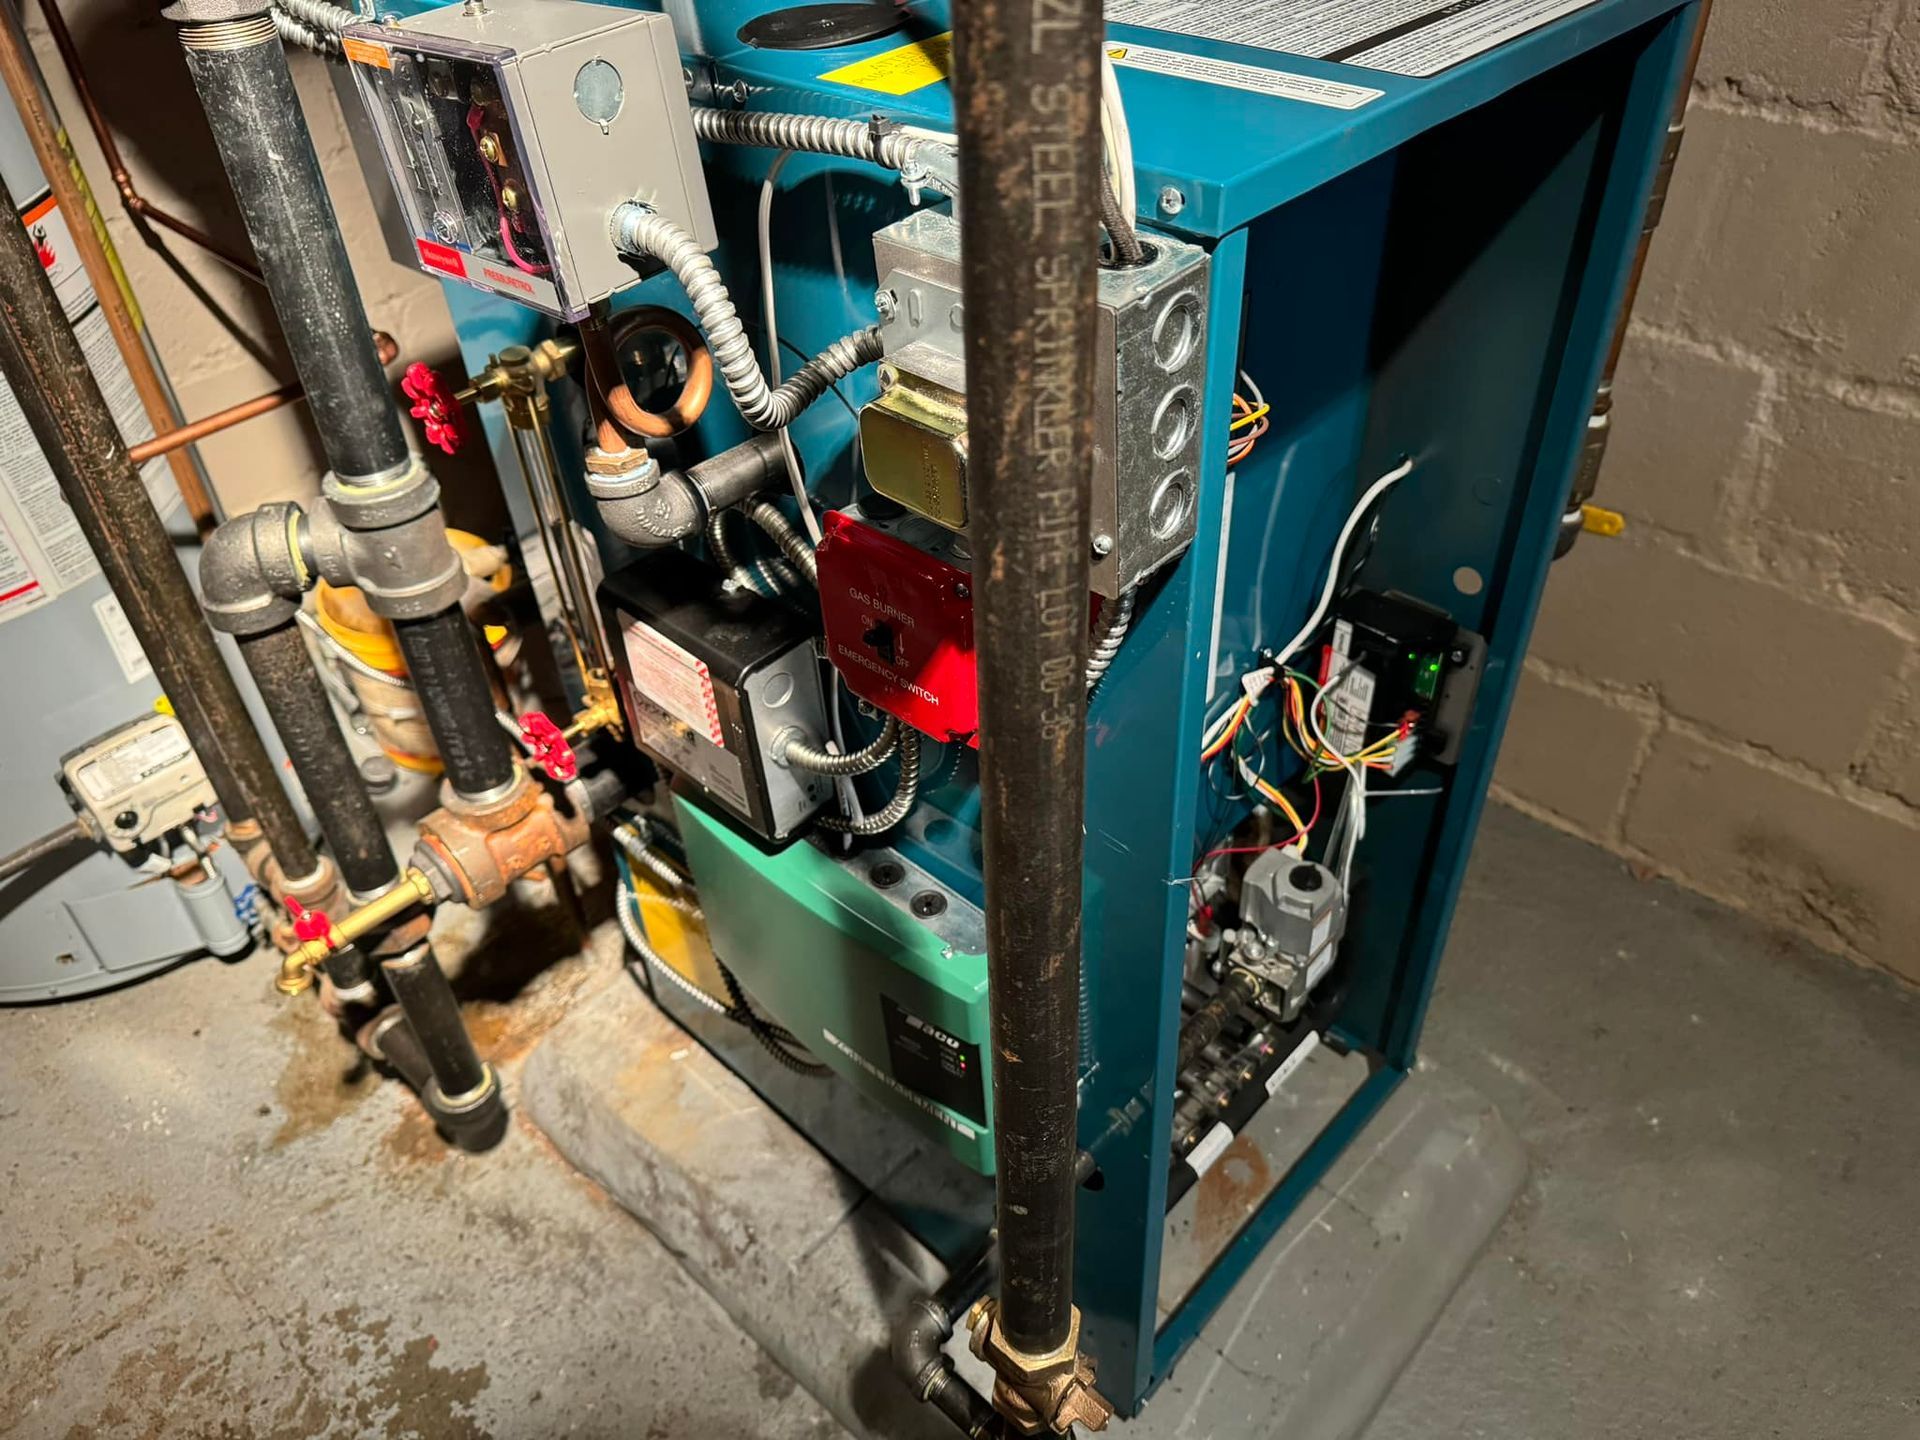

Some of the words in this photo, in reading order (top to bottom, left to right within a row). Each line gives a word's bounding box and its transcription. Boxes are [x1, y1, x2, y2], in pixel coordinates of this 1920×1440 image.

[1033, 252, 1079, 472] SPRINKLER
[1037, 486, 1080, 573] PIPE
[849, 587, 871, 606] GAS
[872, 600, 915, 628] BURNER
[860, 614, 873, 627] ON
[1034, 582, 1080, 638] LOT
[837, 643, 898, 683] EMERGENCY
[899, 677, 939, 706] SWITCH
[895, 655, 910, 668] OFF
